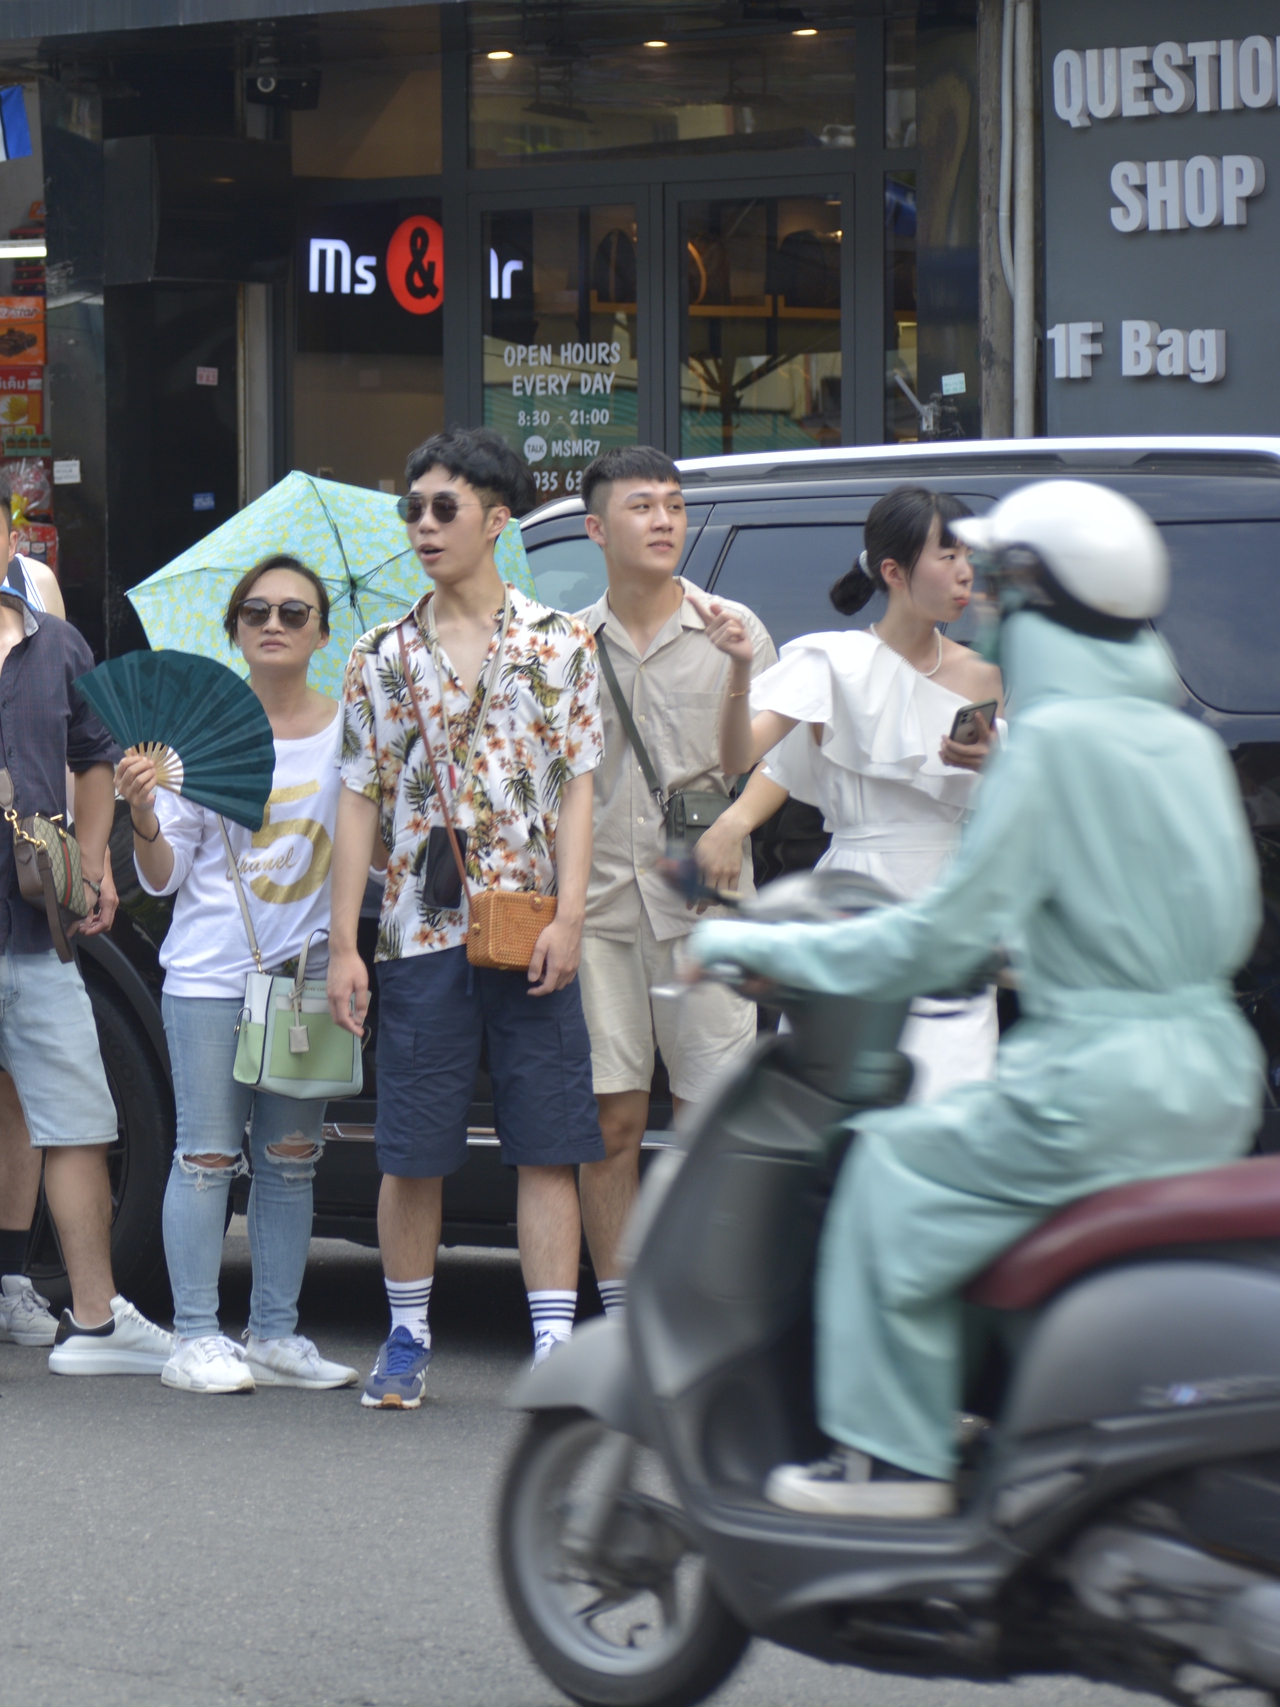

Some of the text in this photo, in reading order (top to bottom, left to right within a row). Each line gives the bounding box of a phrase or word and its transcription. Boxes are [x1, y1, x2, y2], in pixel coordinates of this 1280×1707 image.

[1053, 35, 1280, 128] QUESTIO
[1110, 154, 1266, 233] SHOP
[309, 238, 377, 294] Ms
[503, 342, 621, 368] OPEN HOURS
[1047, 320, 1227, 384] 1F Bag
[512, 371, 616, 396] EVERY DAY
[517, 410, 550, 426] 8:30
[570, 408, 610, 425] 21:00
[527, 439, 601, 457] TALK MSMR7
